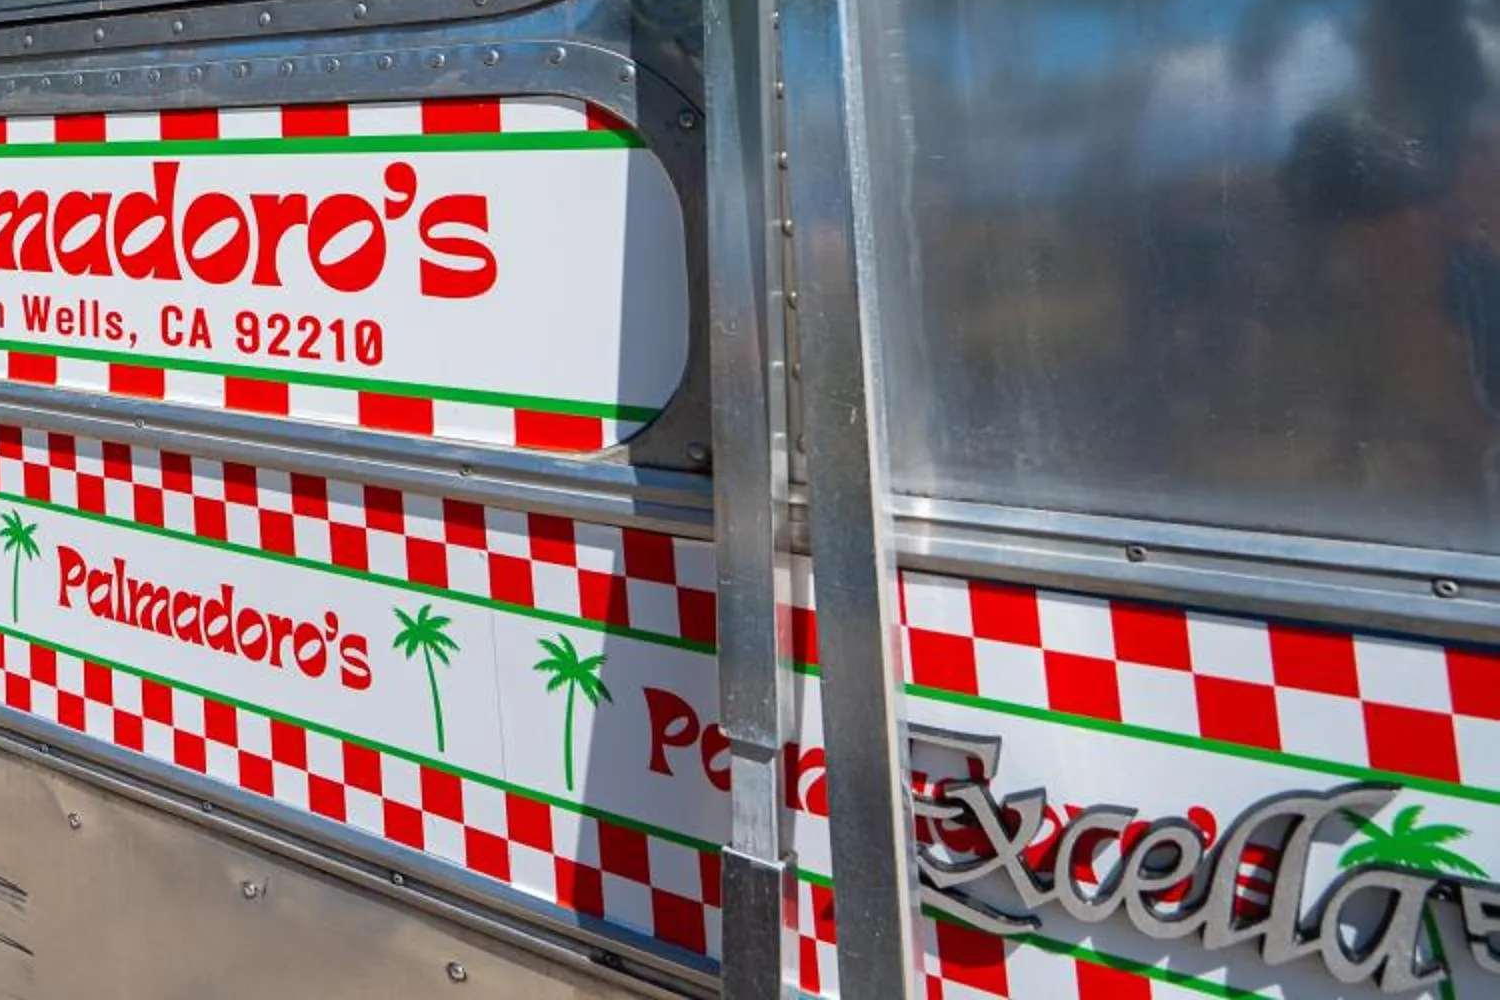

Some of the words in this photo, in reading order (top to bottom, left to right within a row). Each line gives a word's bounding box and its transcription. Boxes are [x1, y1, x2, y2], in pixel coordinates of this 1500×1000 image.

[21, 294, 139, 348] Wells,
[160, 304, 214, 351] CA
[234, 310, 384, 367] 92210
[56, 545, 372, 691] Palmadoro's
